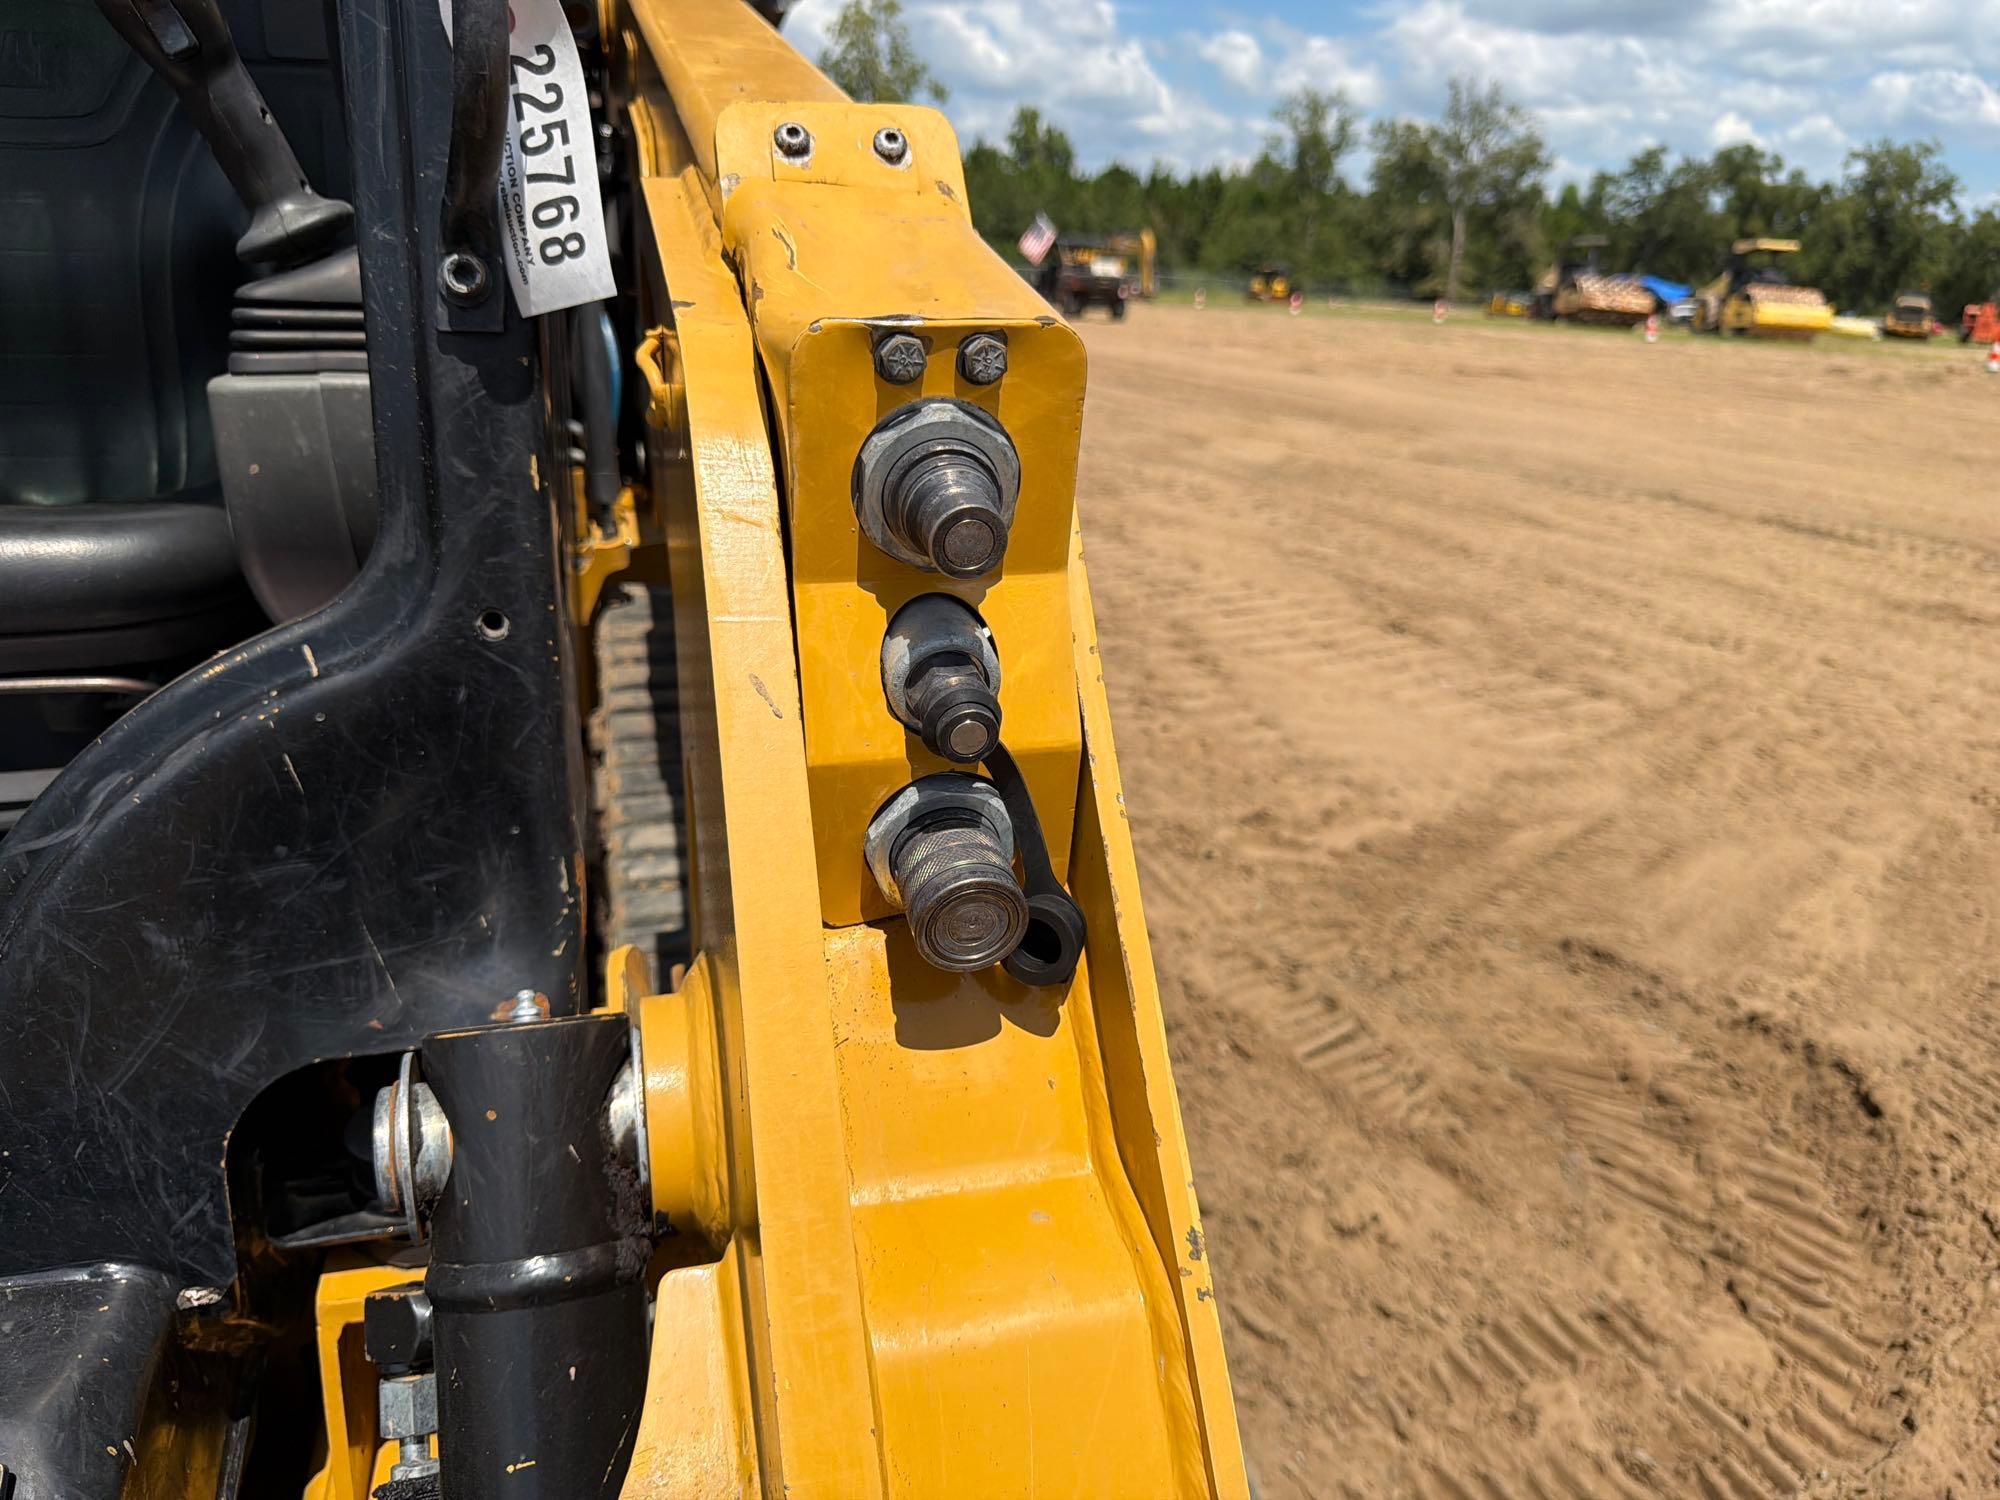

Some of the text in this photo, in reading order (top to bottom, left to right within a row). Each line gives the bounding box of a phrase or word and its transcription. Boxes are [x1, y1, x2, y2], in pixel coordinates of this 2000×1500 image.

[505, 130, 536, 266] UCTION COMPANY
[510, 44, 586, 266] 225768
